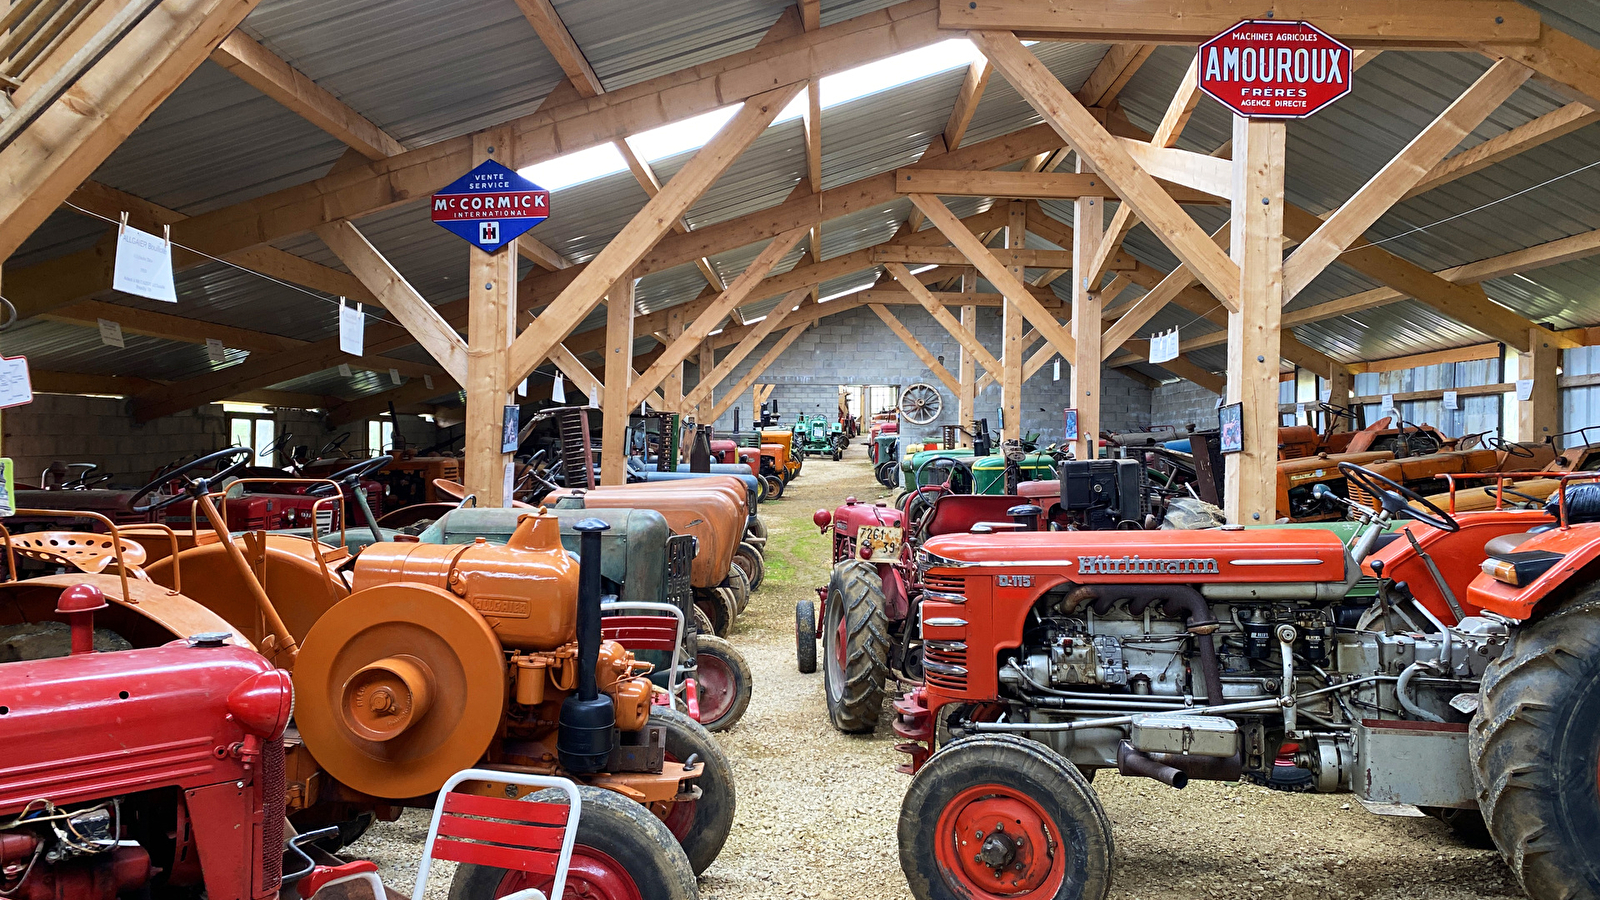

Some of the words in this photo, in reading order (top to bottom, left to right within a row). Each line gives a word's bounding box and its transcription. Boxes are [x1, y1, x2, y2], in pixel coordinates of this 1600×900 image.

[1232, 32, 1273, 41] MACHINES
[1276, 33, 1318, 42] AGRICOLES
[1205, 46, 1343, 84] AMOUROUX
[1241, 99, 1271, 107] AGENCE
[1275, 100, 1307, 108] DIRECTE
[454, 210, 527, 218] INTERNATIONAL
[883, 541, 895, 553] 39
[1077, 555, 1220, 575] Hürlimann
